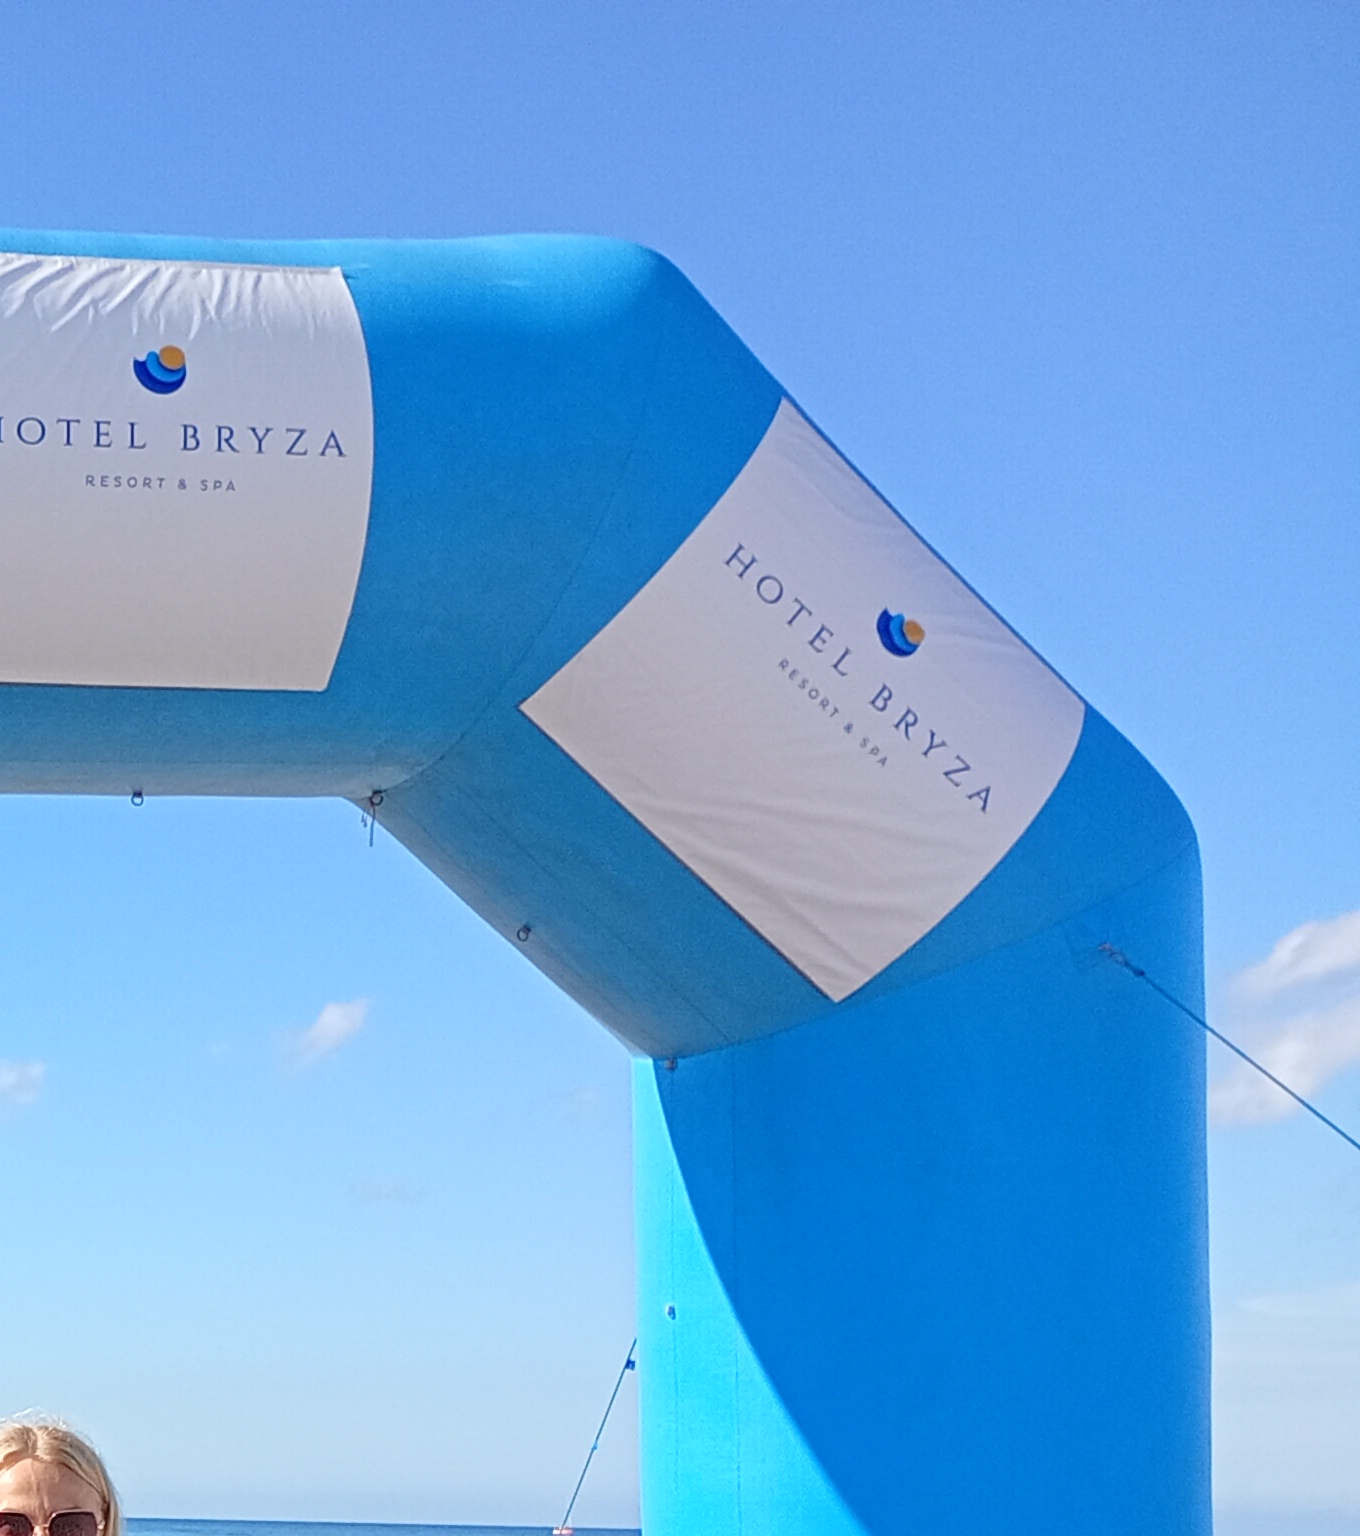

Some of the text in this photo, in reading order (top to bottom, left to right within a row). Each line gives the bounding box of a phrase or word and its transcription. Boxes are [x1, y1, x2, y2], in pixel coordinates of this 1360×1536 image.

[180, 423, 349, 458] BRYZA
[84, 474, 237, 492] RESORT & SPA
[724, 542, 993, 814] HOTEL BRYZA
[778, 658, 889, 768] RESORT & SPA
